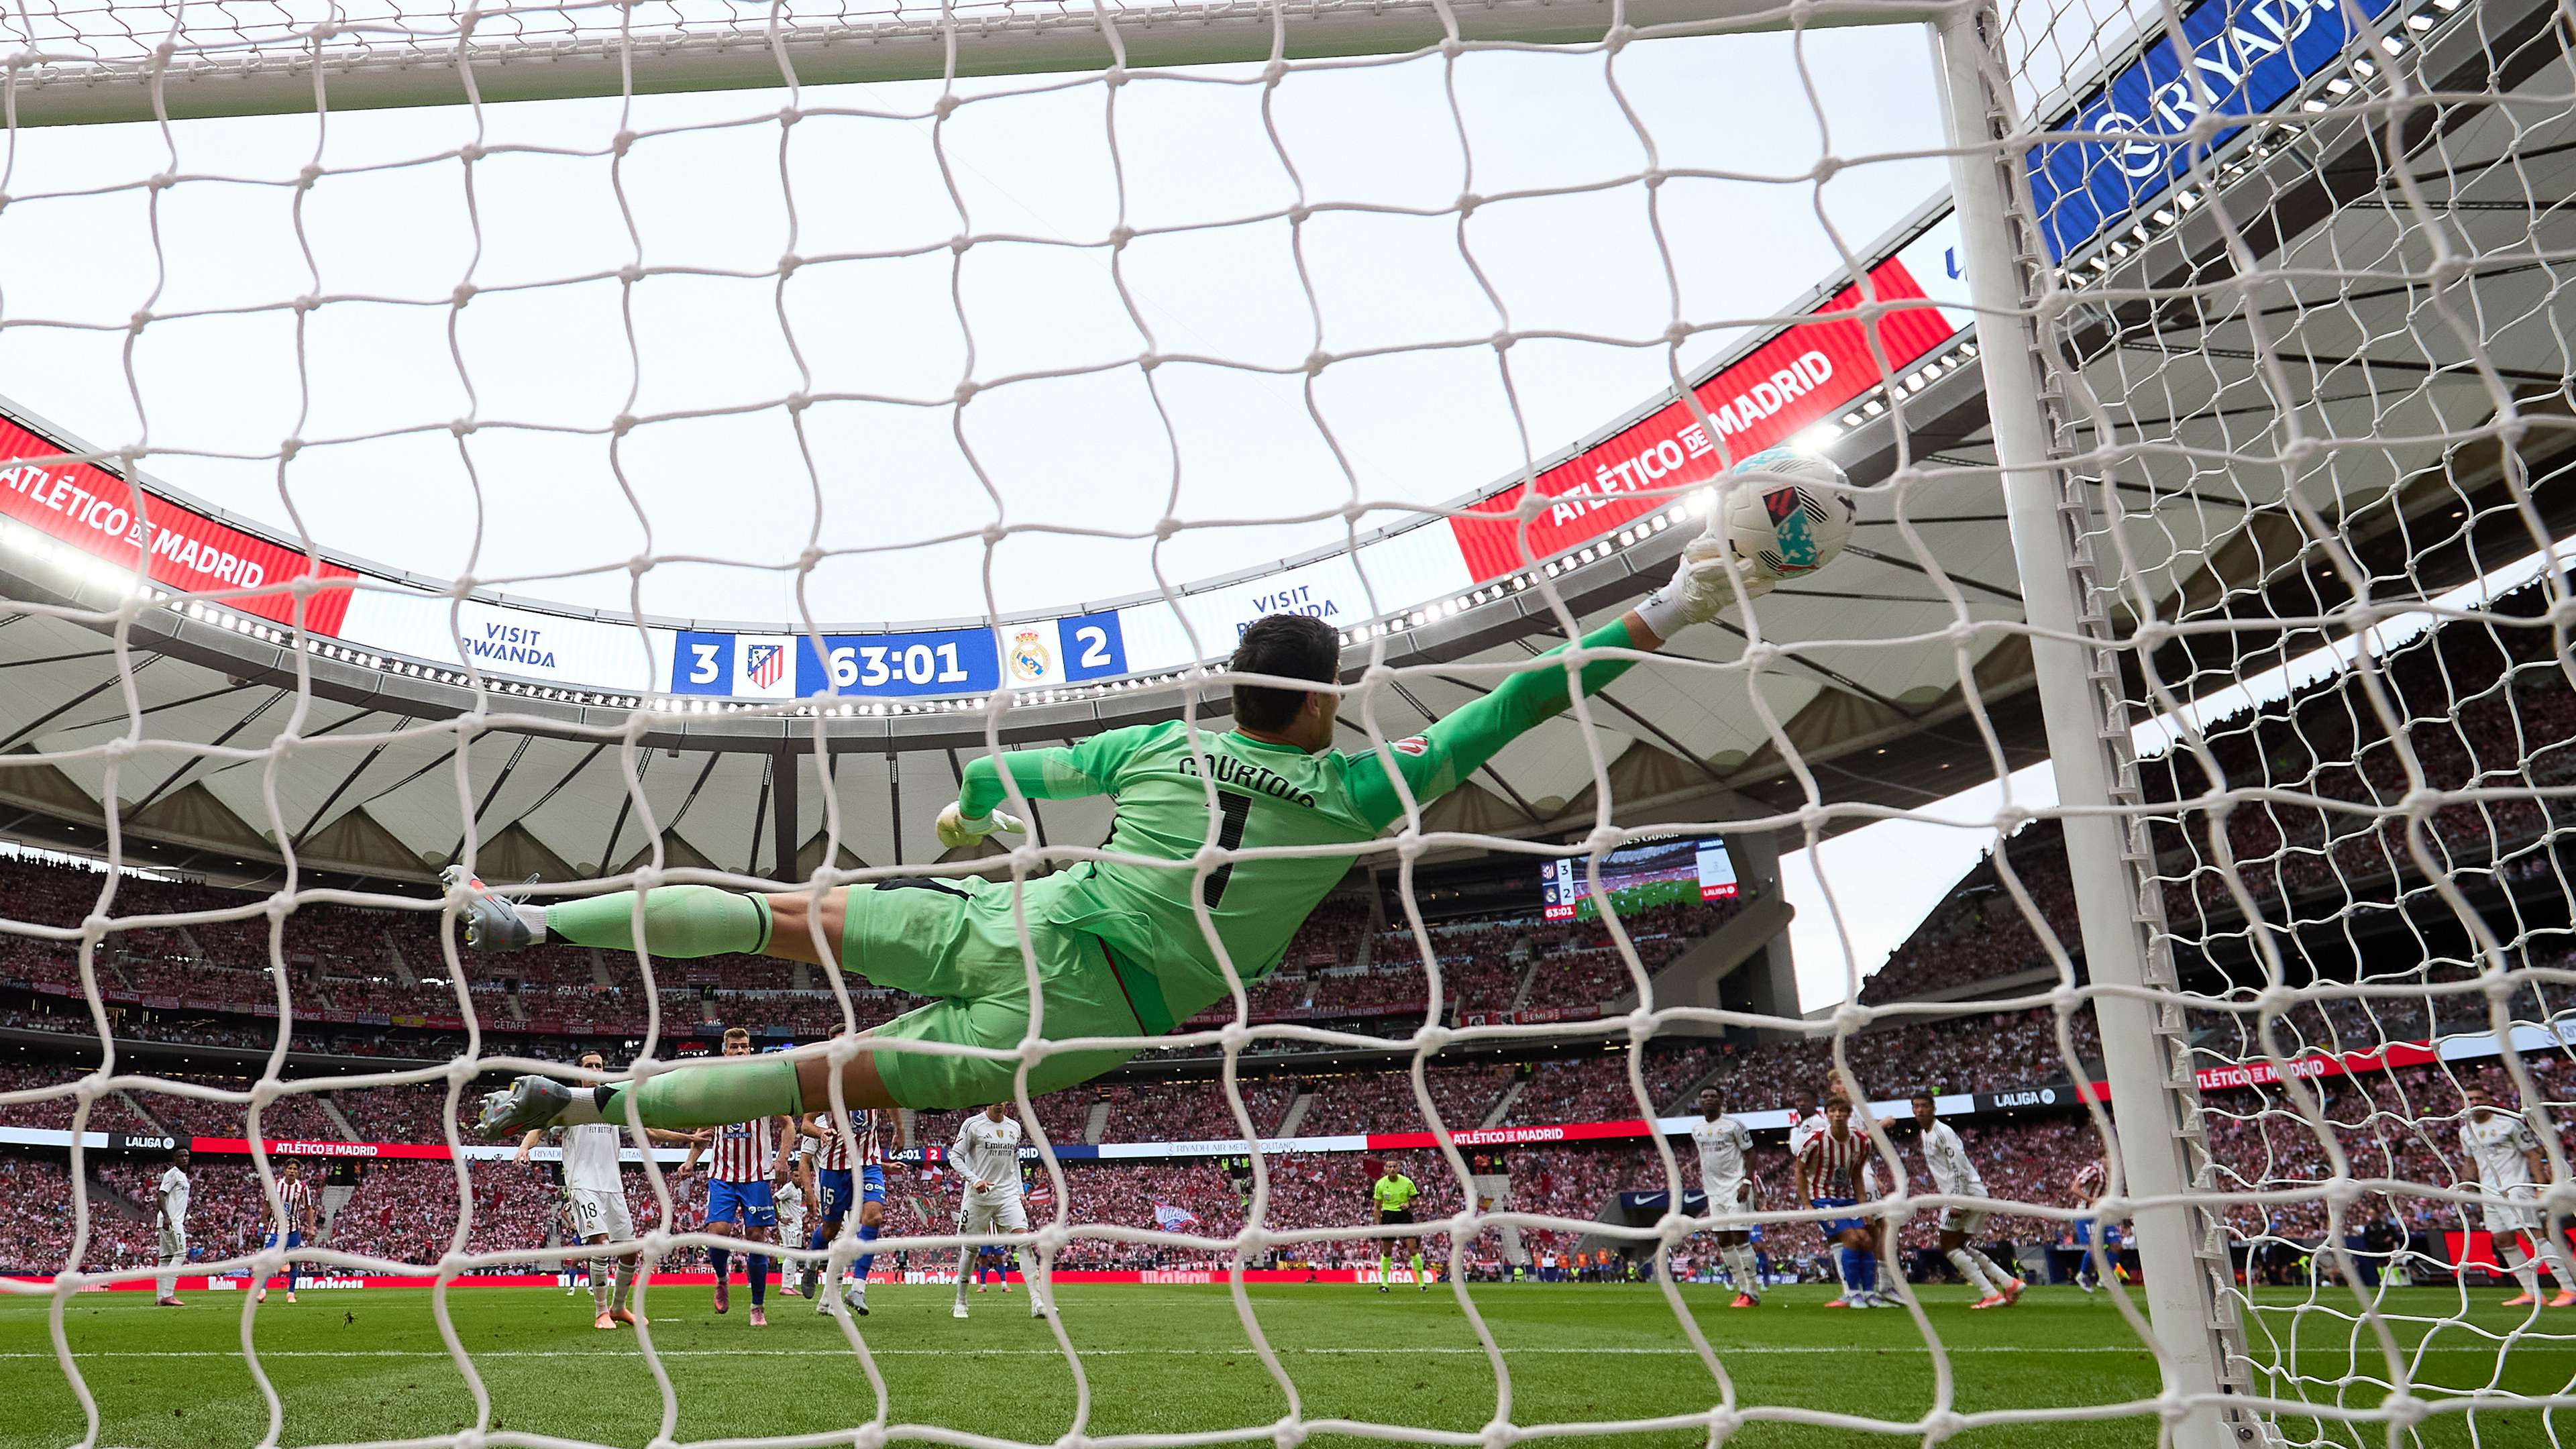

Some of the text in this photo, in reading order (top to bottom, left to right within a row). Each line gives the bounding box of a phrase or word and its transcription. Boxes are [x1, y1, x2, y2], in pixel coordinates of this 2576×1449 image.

[2148, 0, 2335, 131] RIYAD
[1550, 351, 1833, 526] ATLÉTICO DE MADRID
[0, 455, 129, 536] ATLÉTICO
[151, 529, 263, 588] MADRID
[1253, 586, 1309, 613] VISIT
[487, 623, 540, 645] VISIT
[458, 637, 555, 667] RWANDA
[1076, 626, 1111, 668] 2
[690, 643, 719, 684] 3
[830, 642, 968, 687] 63:01
[1204, 788, 1253, 910] 1
[1561, 865, 1568, 875] 3
[1564, 889, 1571, 899] 2
[1704, 888, 1727, 897] LALIGA
[1546, 907, 1574, 918] 63:01
[494, 1020, 527, 1030] GETAFE
[2196, 1069, 2250, 1089] TLÉTICO
[1994, 1092, 2039, 1107] LALIGA
[125, 1136, 162, 1148] LALIGA
[1454, 1131, 1505, 1144] ATLÉTICO
[1516, 1128, 1564, 1141] MADRID
[276, 1142, 325, 1155] ATLÉTICO
[335, 1146, 378, 1156] MADRID
[930, 1149, 938, 1160] 2
[1177, 1144, 1209, 1154] RIYADH
[1212, 1144, 1225, 1153] AIR
[822, 1186, 835, 1205] 15
[581, 1203, 597, 1220] 18
[961, 1210, 969, 1224] 8
[177, 1233, 181, 1242] 7
[788, 1231, 796, 1239] 10
[294, 1277, 363, 1289] Mahou
